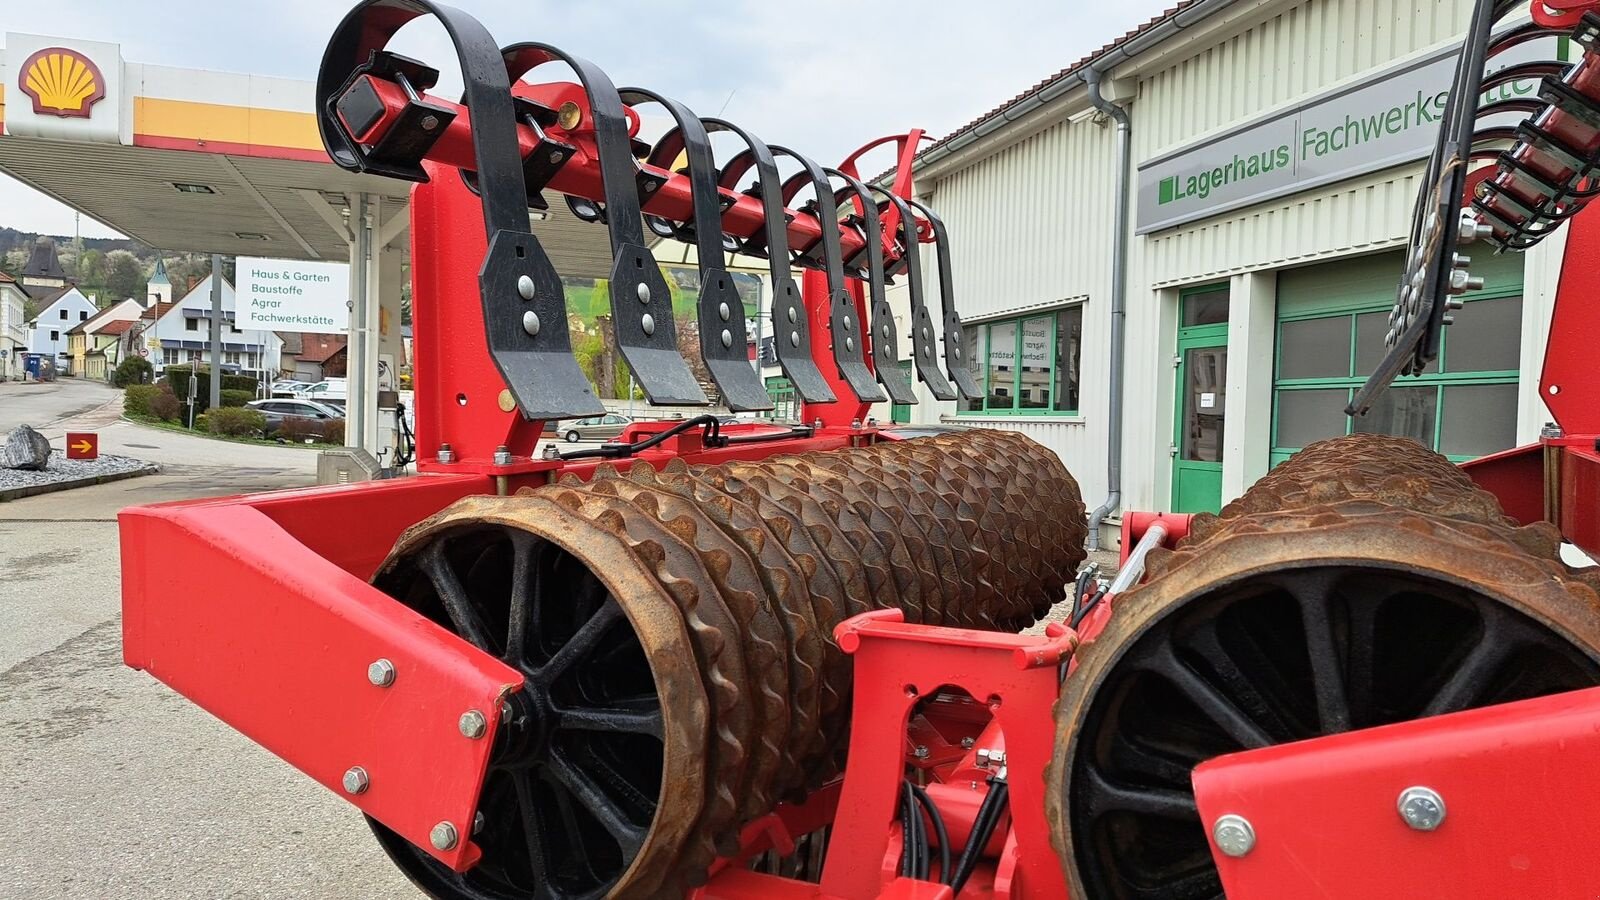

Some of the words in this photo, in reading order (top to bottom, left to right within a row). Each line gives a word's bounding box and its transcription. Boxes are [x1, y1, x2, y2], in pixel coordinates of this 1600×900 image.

[1175, 145, 1290, 200] Lagerhaus
[251, 269, 279, 279] Haus
[282, 271, 290, 280] &
[293, 272, 330, 283] Garten
[251, 284, 303, 295] Baustoffe
[251, 298, 282, 309] Agrar
[251, 312, 334, 325] Fachwerkstätte
